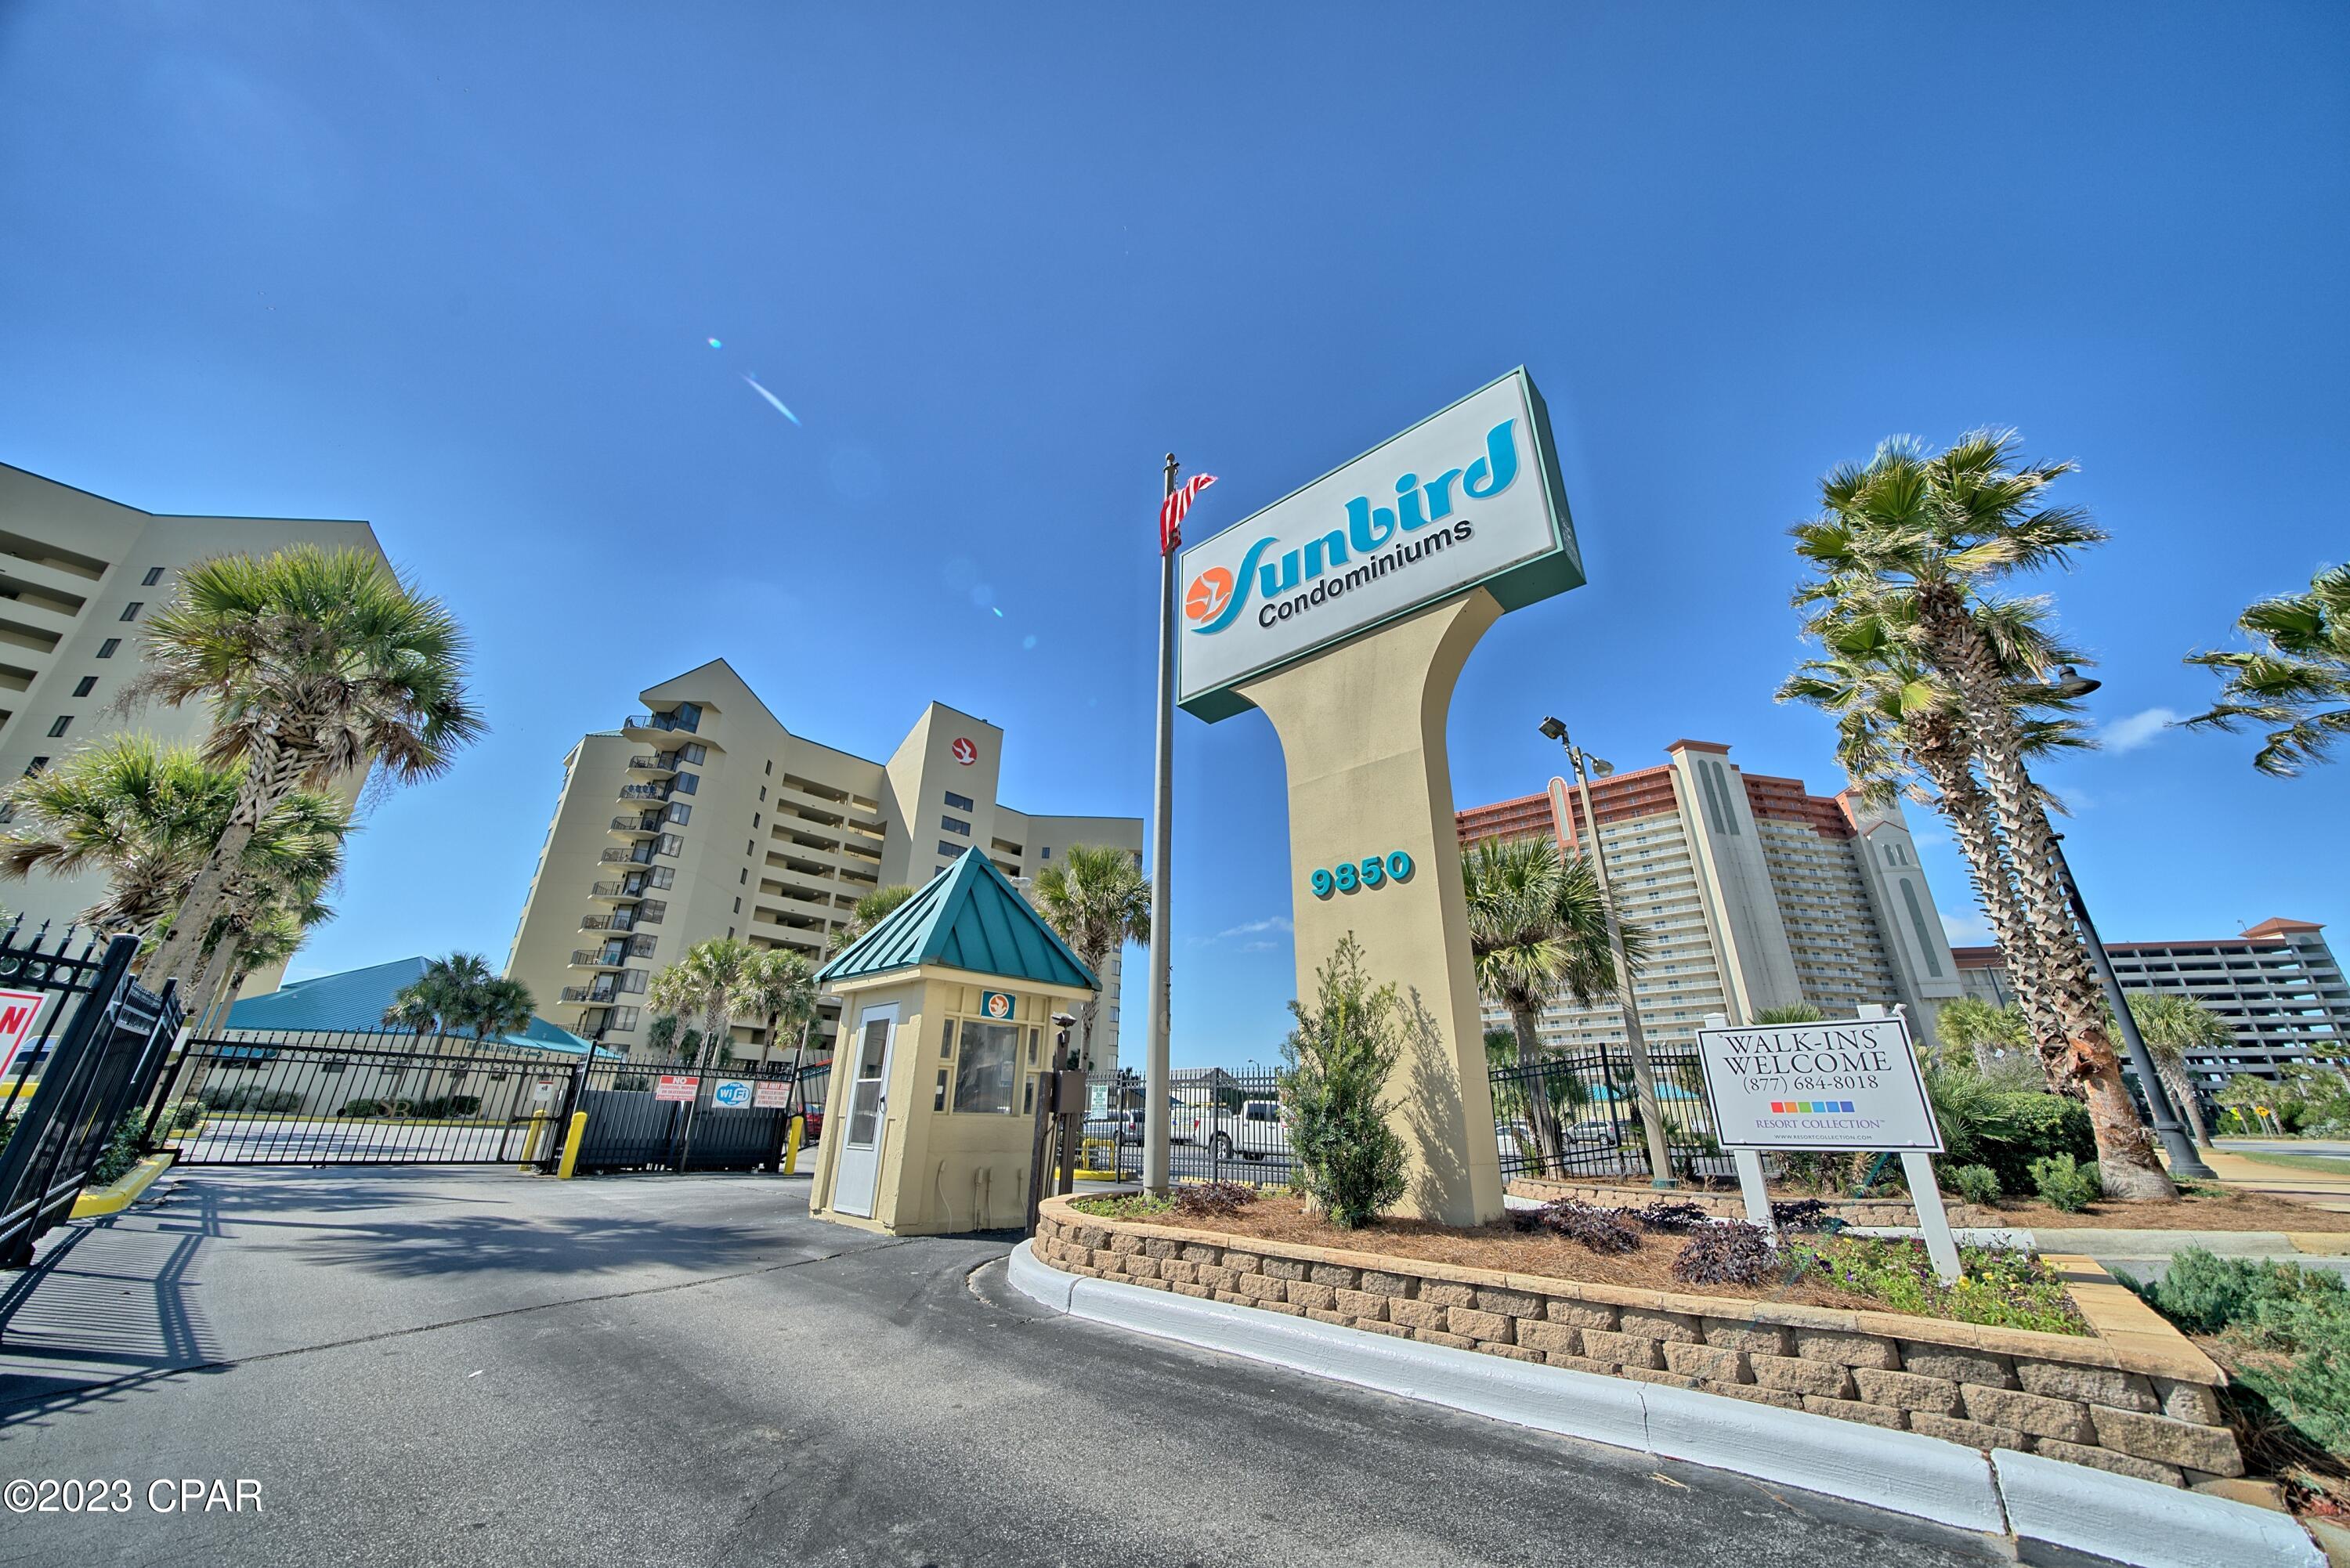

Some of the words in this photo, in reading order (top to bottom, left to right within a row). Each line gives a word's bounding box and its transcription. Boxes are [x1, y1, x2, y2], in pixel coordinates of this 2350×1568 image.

[1190, 417, 1517, 634] Sunbird
[1258, 520, 1473, 628] Condominiums
[1311, 851, 1411, 896] 9850
[497, 1046, 523, 1056] OFFICE
[1724, 1028, 1878, 1054] WALK-INS
[1723, 1051, 1892, 1075] WELCOME
[1743, 1076, 1788, 1094] (877)
[1794, 1075, 1878, 1090] 684-8018
[1756, 1120, 1798, 1129] RESORT
